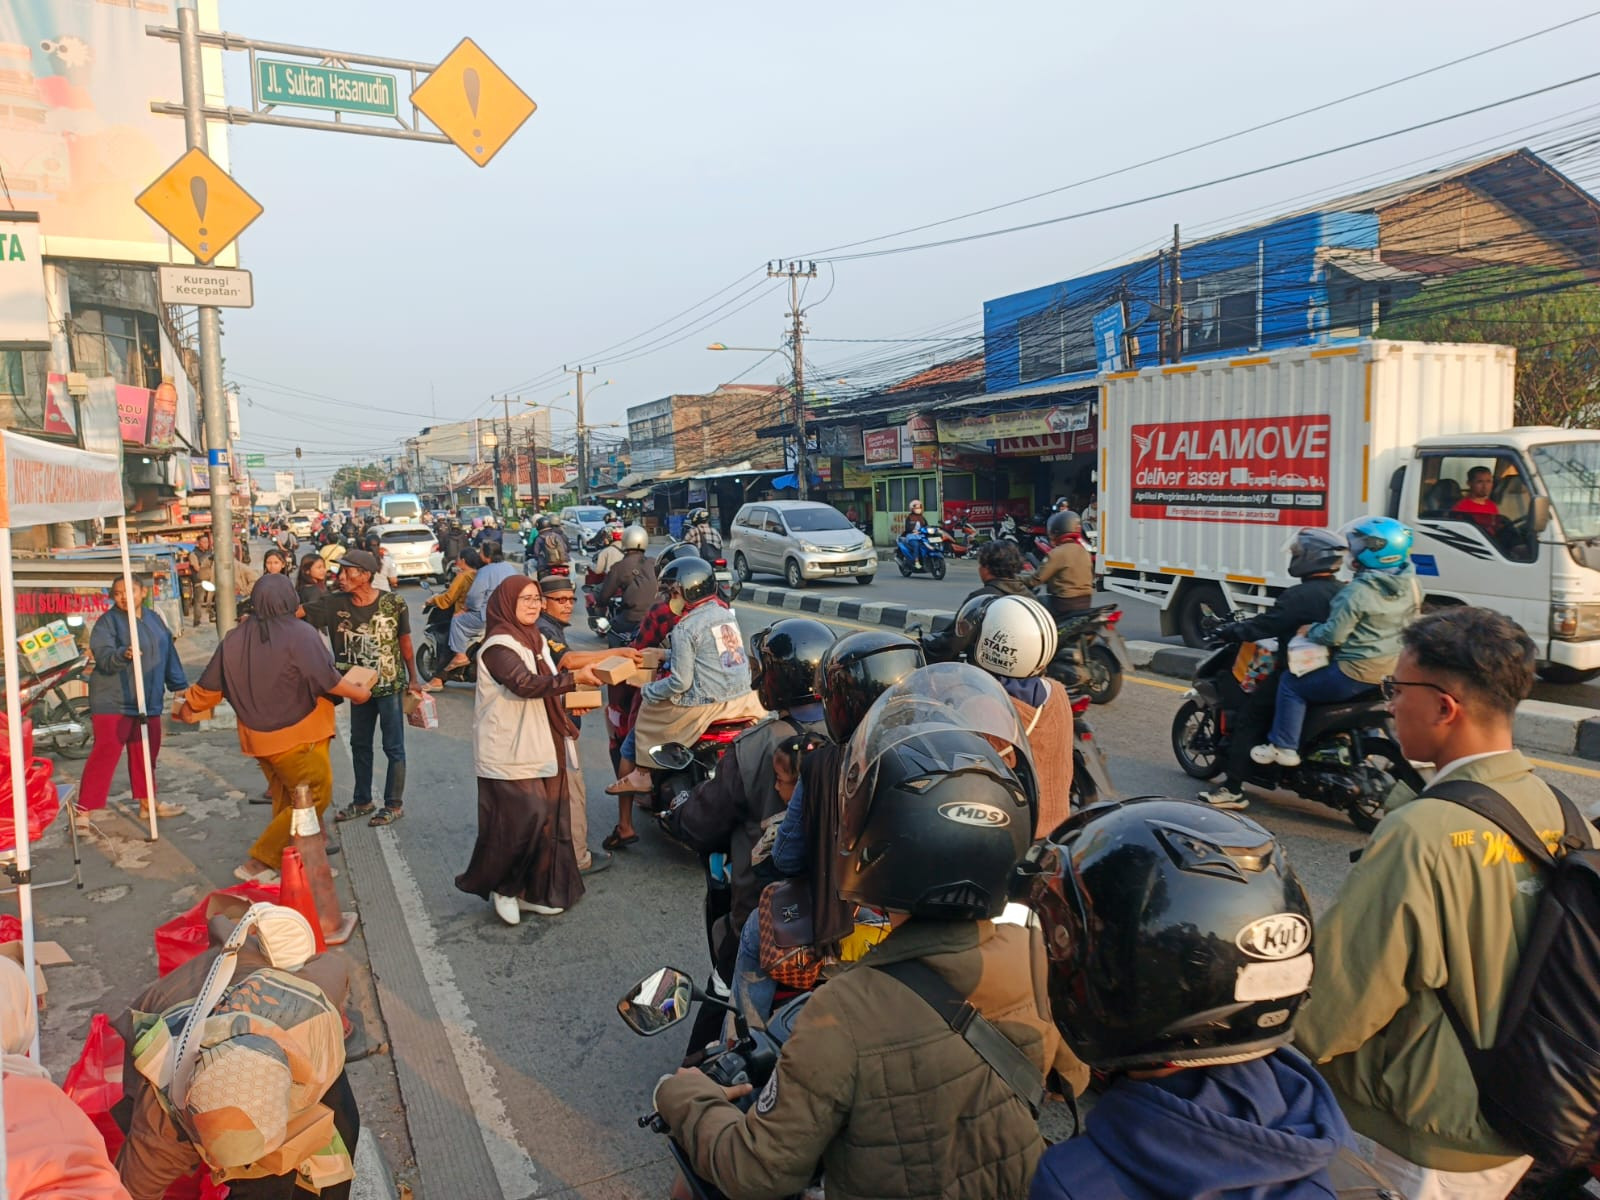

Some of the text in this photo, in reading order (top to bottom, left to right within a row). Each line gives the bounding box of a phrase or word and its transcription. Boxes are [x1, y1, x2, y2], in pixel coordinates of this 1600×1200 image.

[267, 64, 390, 106] Jl. Sultan Hasanudin
[176, 285, 238, 297] Kecepatan
[183, 275, 229, 288] Kurangi
[1155, 424, 1329, 461] LALAMOVE
[1135, 467, 1184, 486] deliver
[38, 591, 110, 614] SUMEDANG
[983, 638, 1018, 656] START
[956, 807, 1000, 822] MDS
[1449, 829, 1476, 848] THE
